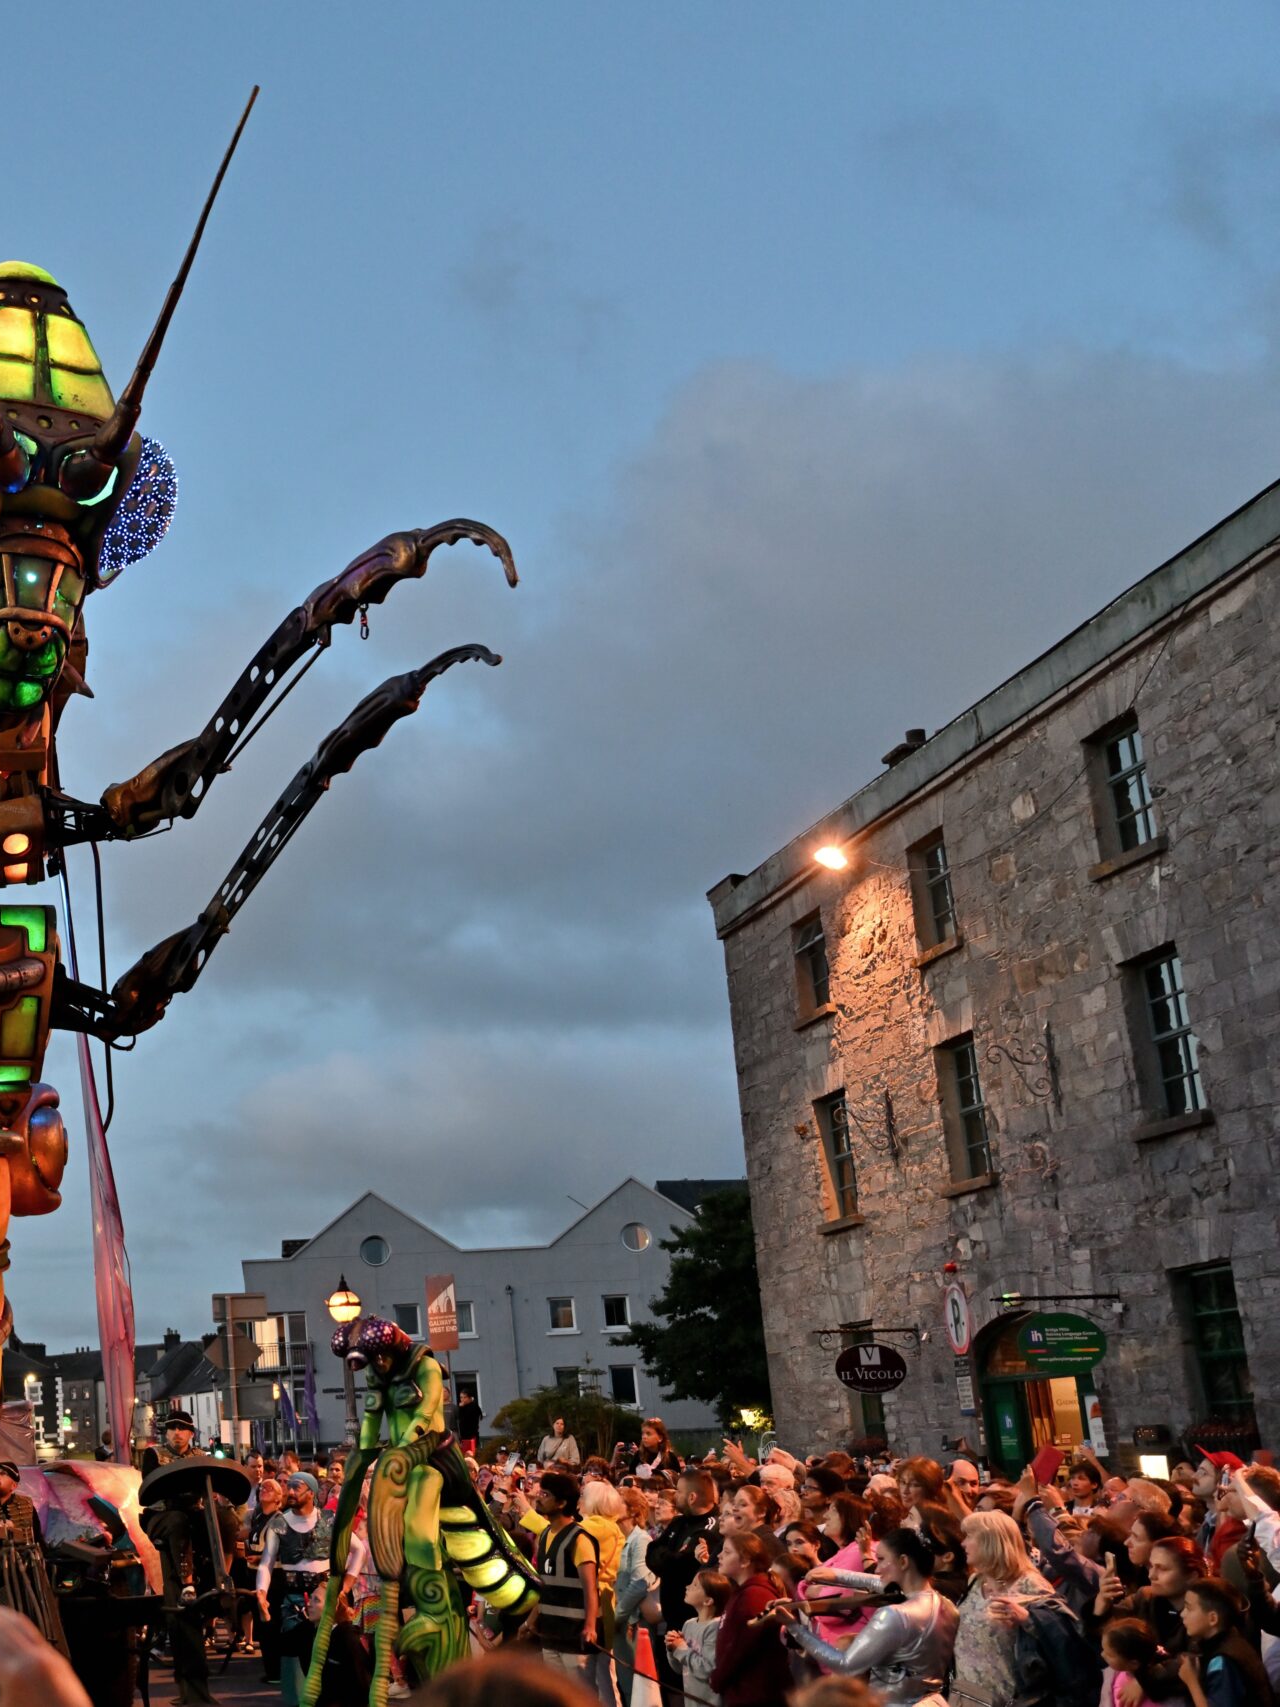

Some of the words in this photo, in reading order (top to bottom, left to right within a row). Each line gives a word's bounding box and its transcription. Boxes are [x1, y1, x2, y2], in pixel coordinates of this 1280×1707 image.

[429, 1318, 457, 1327] GALWAY'S
[429, 1326, 445, 1334] WEST
[841, 1371, 854, 1381] IL
